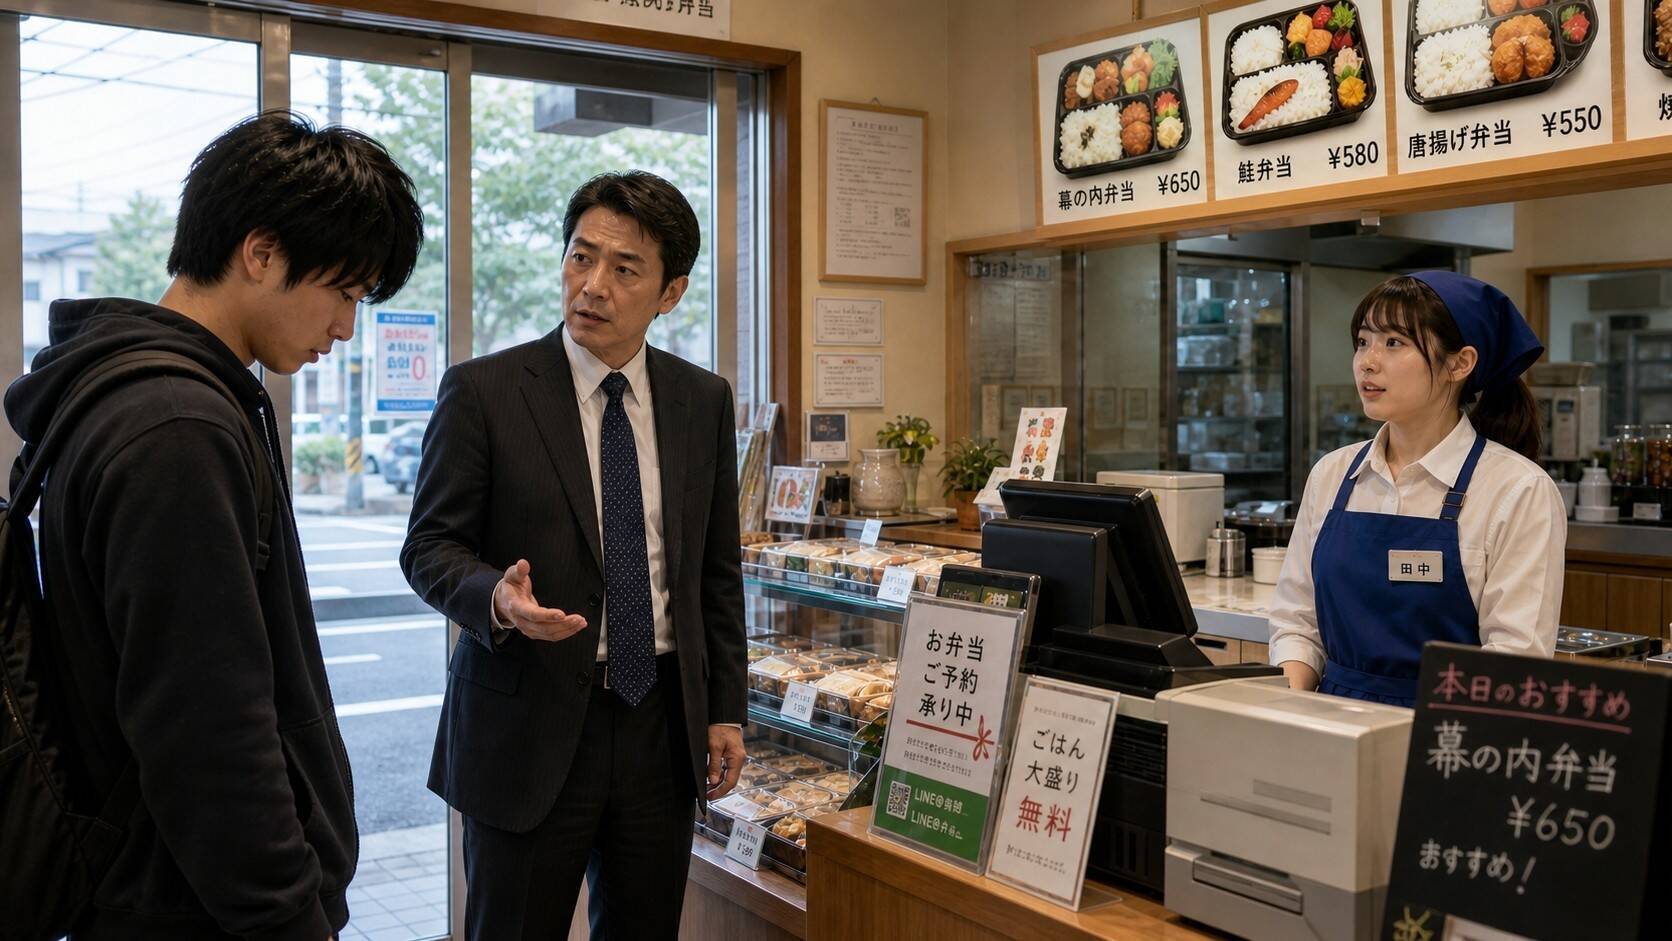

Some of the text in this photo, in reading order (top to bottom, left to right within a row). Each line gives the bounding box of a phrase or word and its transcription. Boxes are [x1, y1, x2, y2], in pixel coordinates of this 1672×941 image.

[1408, 104, 1602, 158] 唐揚げ弁当 ¥550
[1238, 141, 1379, 184] 鮭弁当 ¥580
[1058, 170, 1200, 211] 幕の内弁当 ¥650
[1401, 562, 1430, 576] 田中
[926, 629, 985, 662] お弁当
[924, 661, 978, 695] ご予約
[1433, 662, 1631, 721] 本日のおすすめ
[919, 693, 973, 726] 承り中
[1033, 729, 1085, 760] ごはん
[1427, 720, 1617, 793] 幕の内弁当
[1025, 760, 1079, 794] 大盛り
[1016, 796, 1072, 842] 無料
[1507, 795, 1616, 850] ¥650
